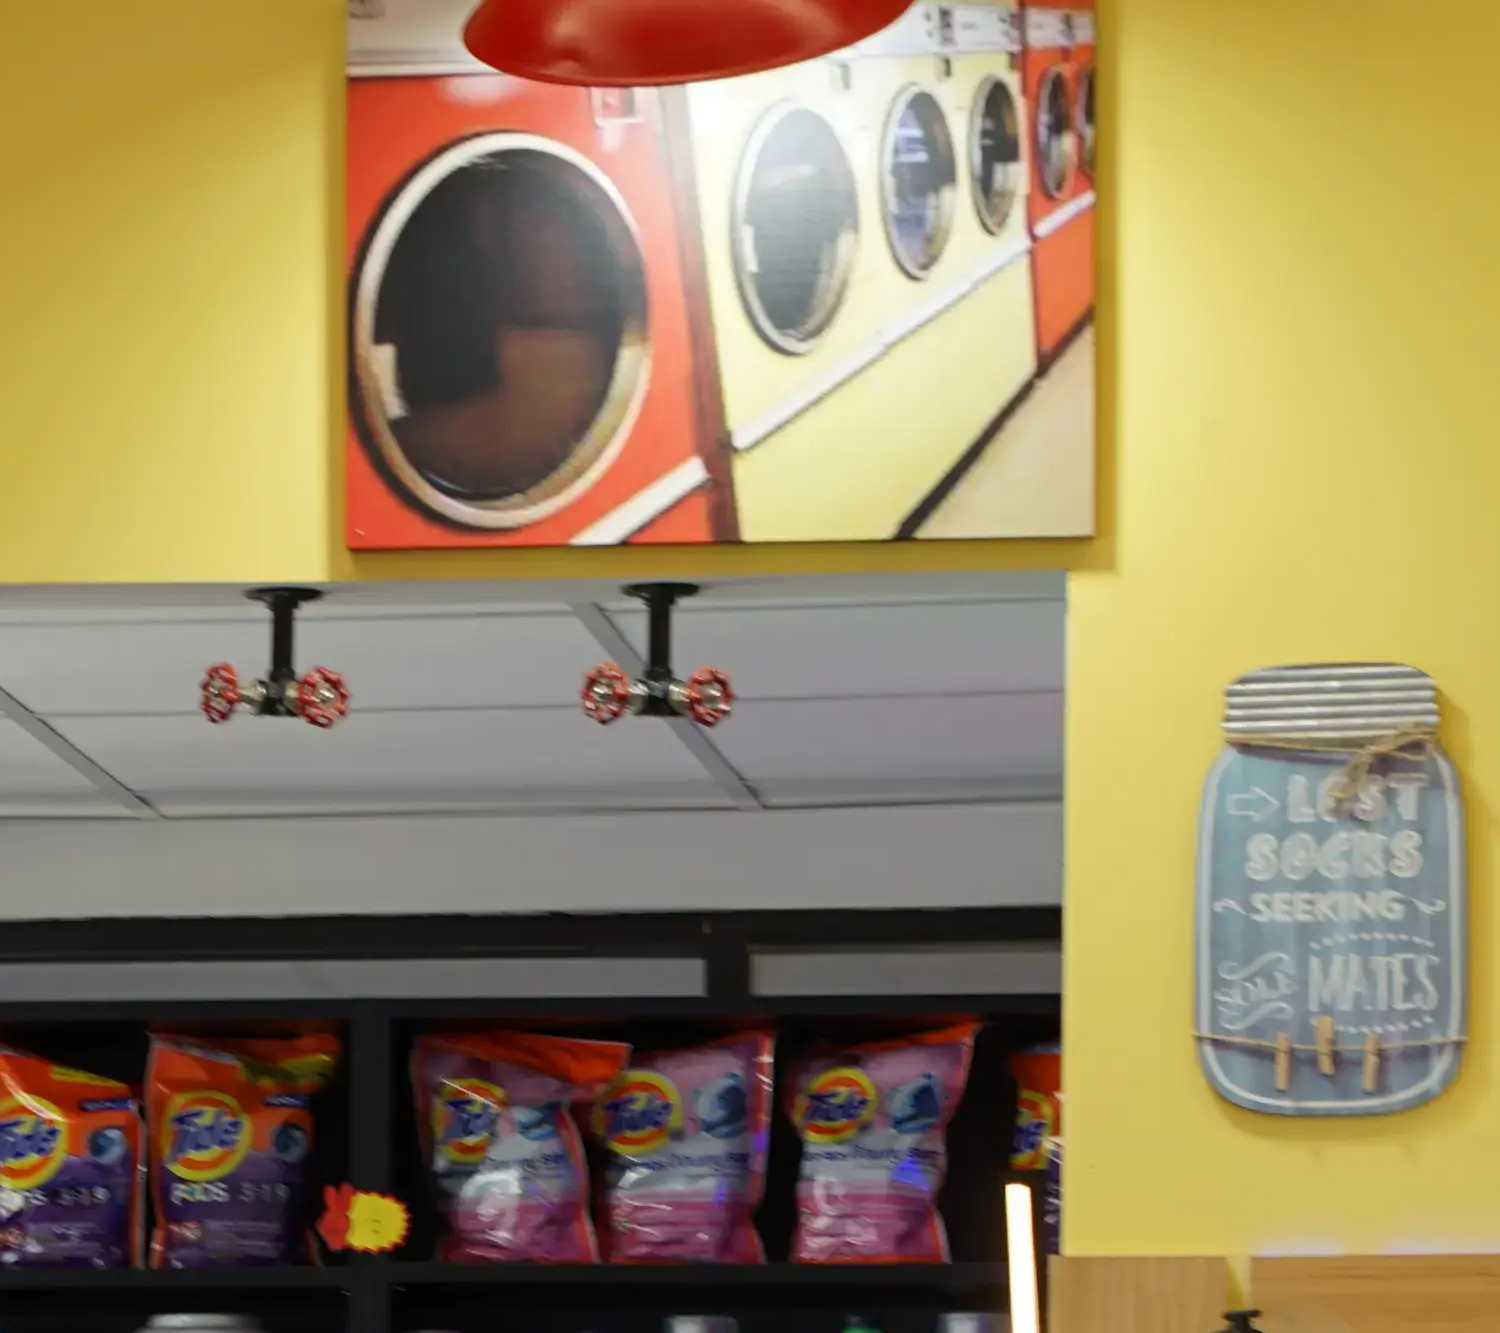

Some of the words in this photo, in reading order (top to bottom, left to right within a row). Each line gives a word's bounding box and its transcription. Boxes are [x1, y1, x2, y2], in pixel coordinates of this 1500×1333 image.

[1286, 773, 1428, 823] LOST
[1245, 829, 1422, 880] SOCKS
[1249, 890, 1405, 921] SEEKING
[1308, 953, 1441, 1011] MATES
